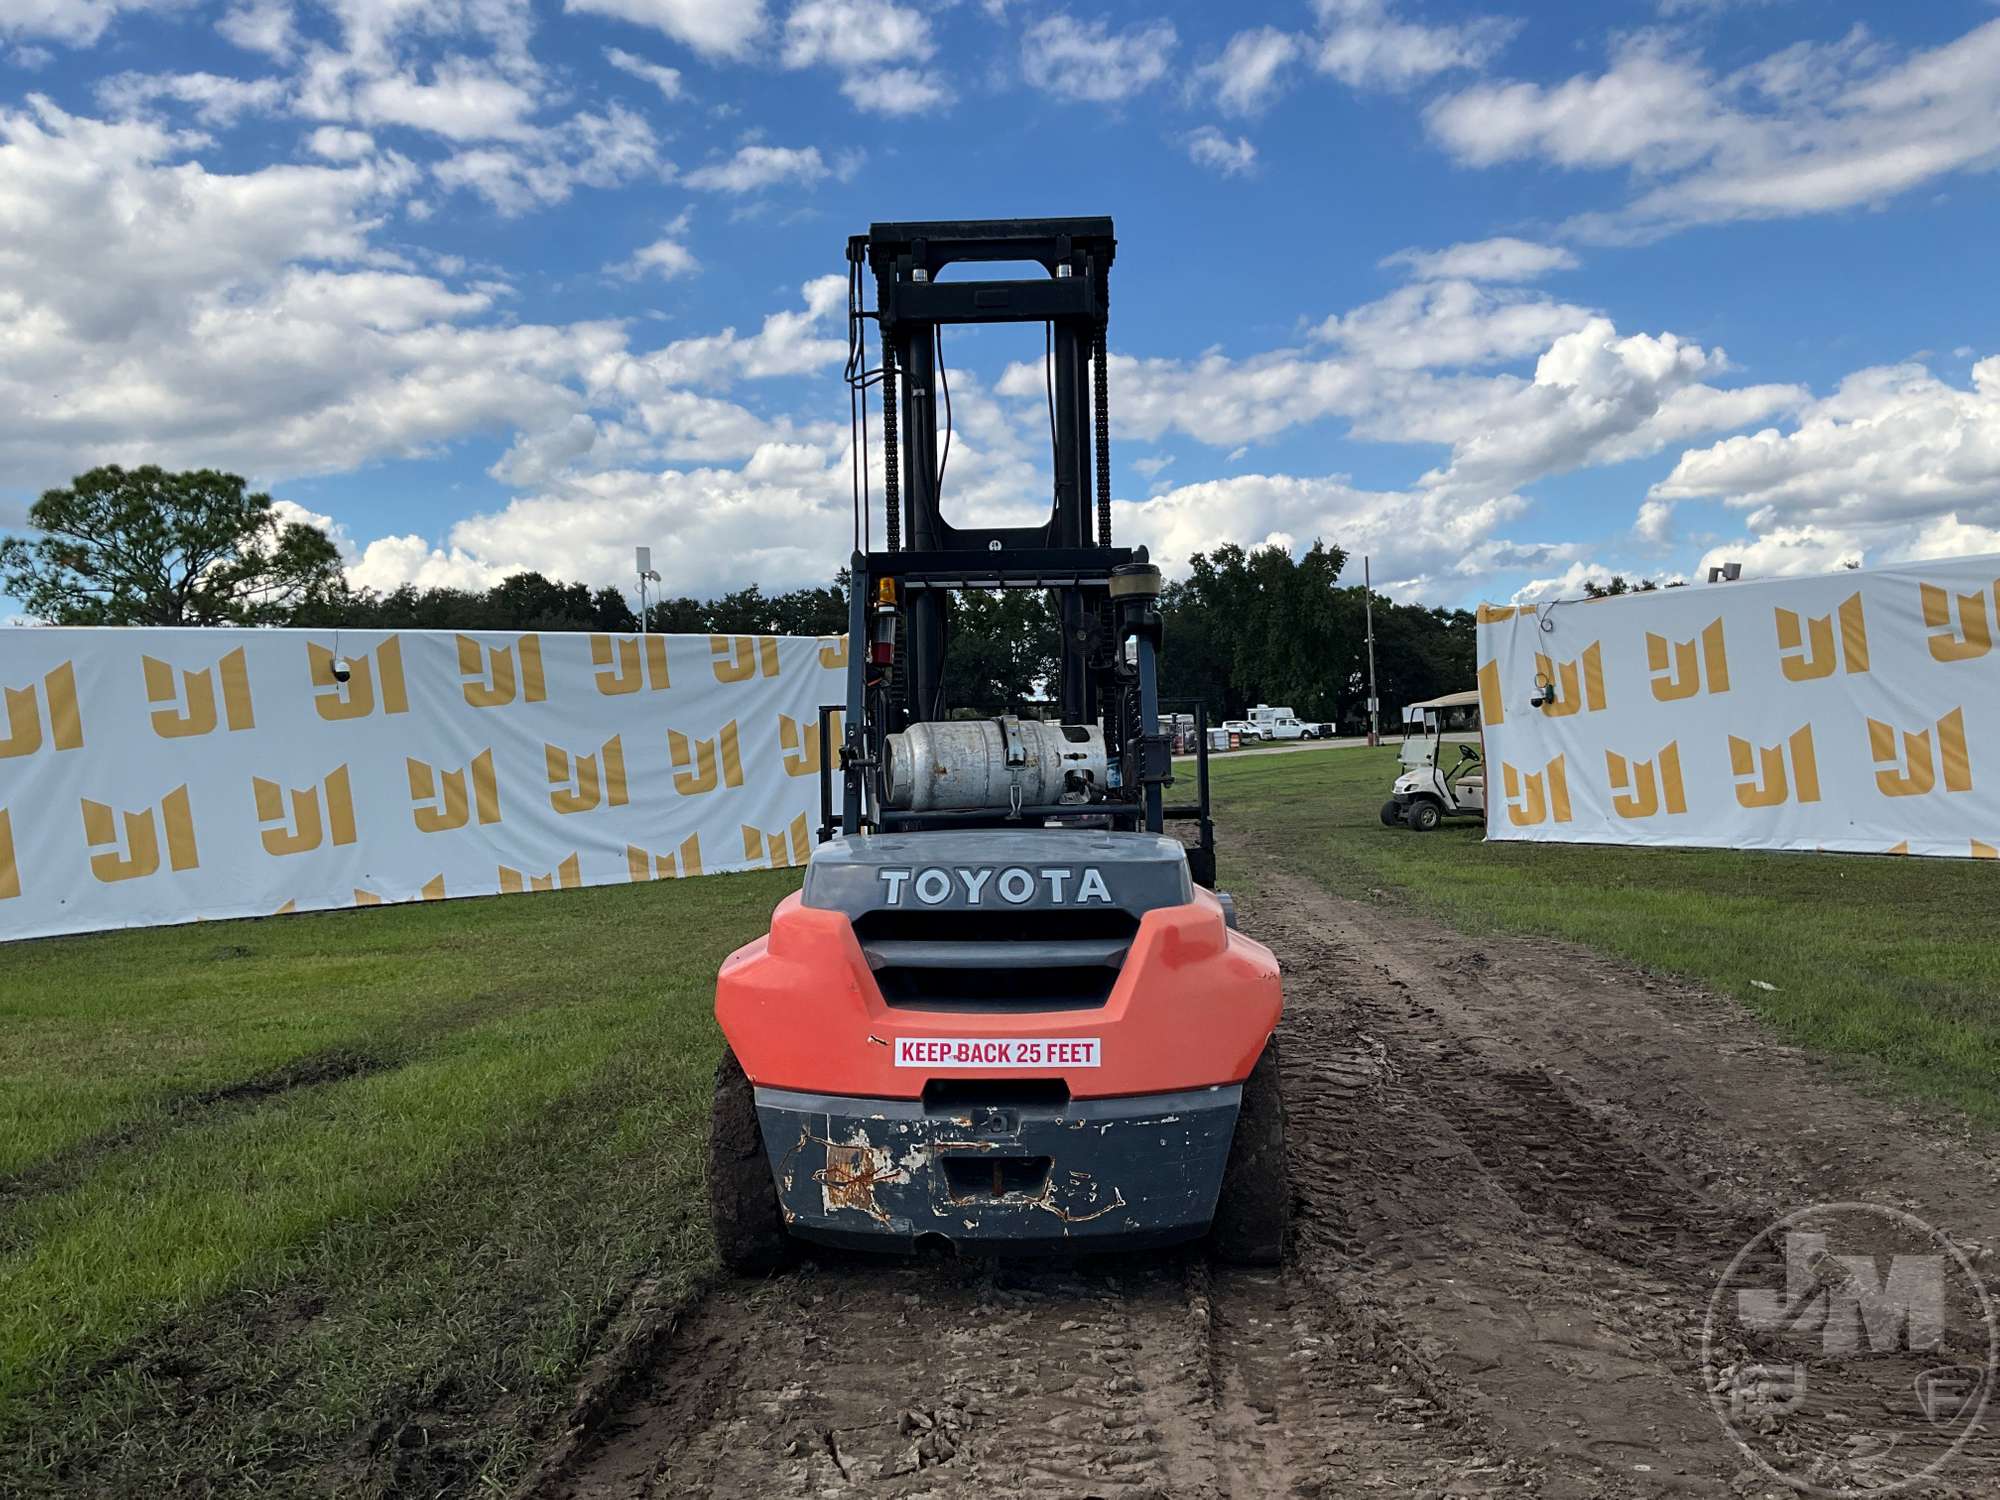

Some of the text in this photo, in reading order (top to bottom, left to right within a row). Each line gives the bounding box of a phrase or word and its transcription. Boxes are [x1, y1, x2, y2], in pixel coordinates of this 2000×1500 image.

[881, 868, 1112, 904] TOYOTA
[902, 1042, 1094, 1062] KEEP BACK 25 FEET
